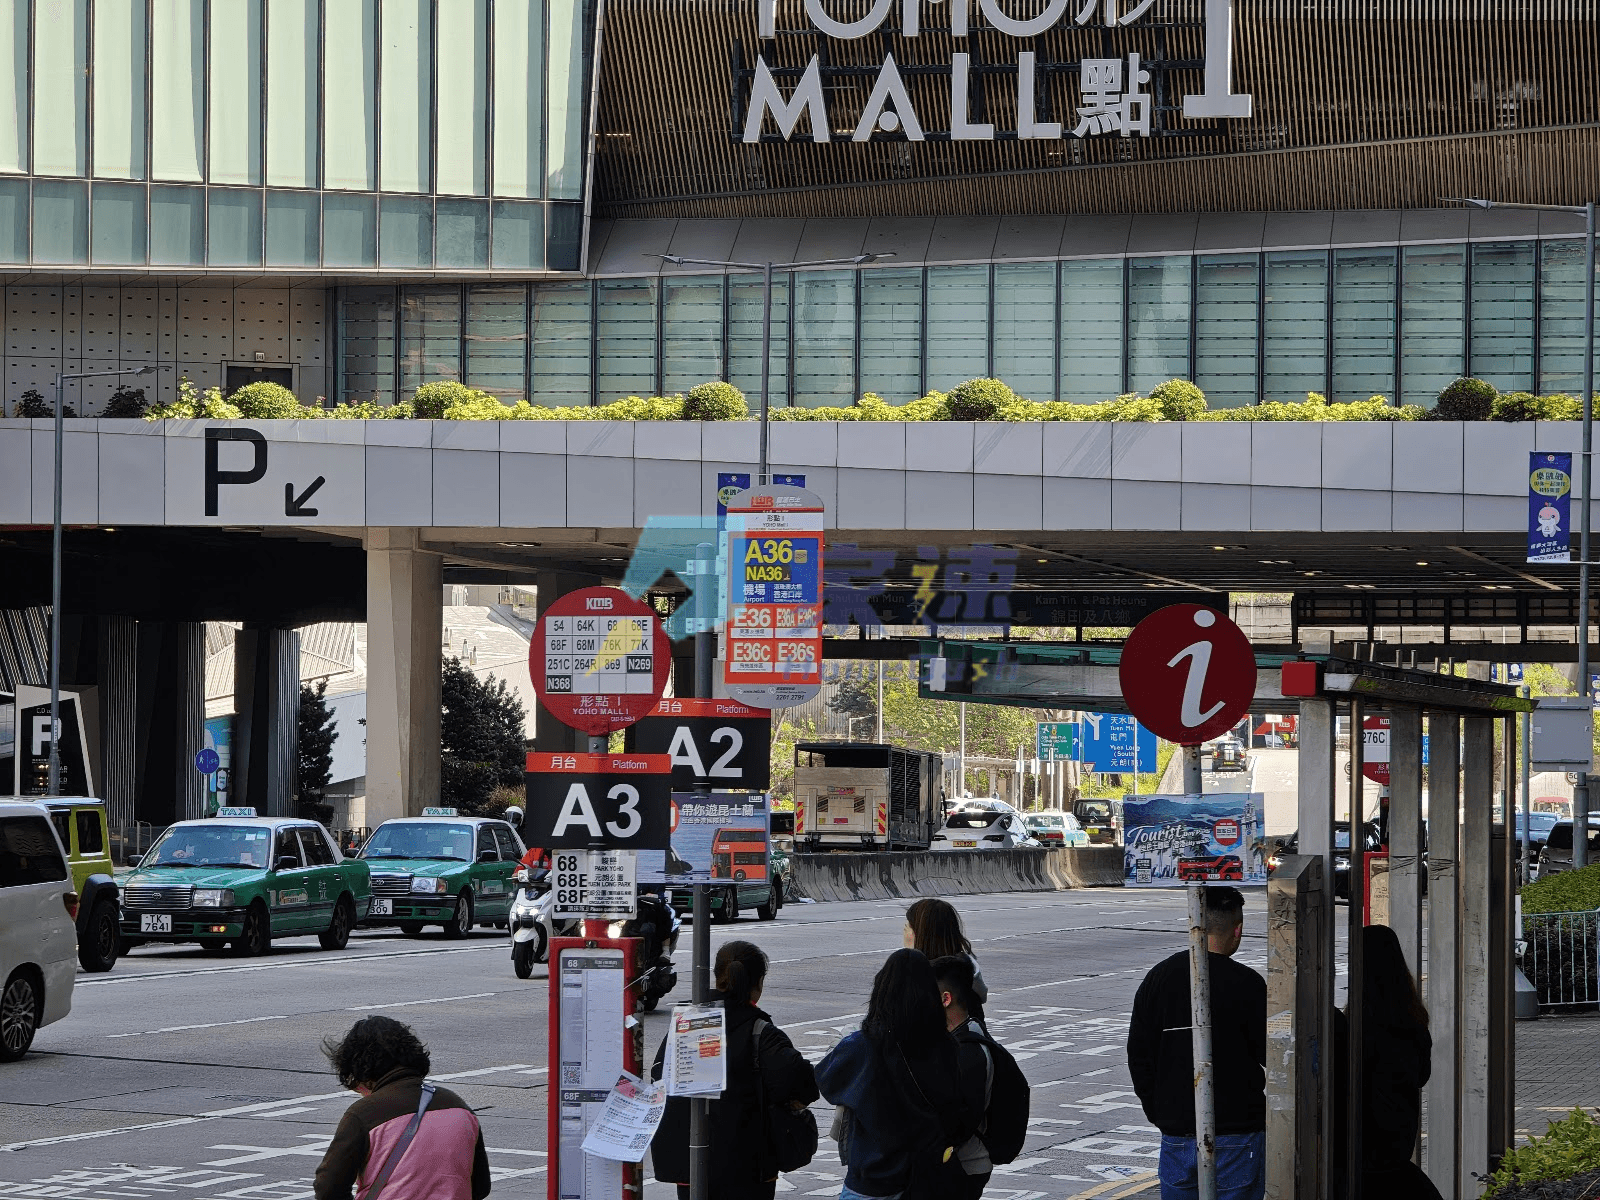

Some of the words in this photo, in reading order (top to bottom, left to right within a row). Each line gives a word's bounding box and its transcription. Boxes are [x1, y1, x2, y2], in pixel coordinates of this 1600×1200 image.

[743, 51, 1061, 143] MALL
[205, 428, 267, 516] P
[745, 540, 793, 563] A36
[746, 566, 783, 581] NA36
[743, 584, 765, 595] 機場
[586, 598, 614, 610] KMB
[882, 594, 905, 603] Mun
[1035, 596, 1058, 605] Kam
[1060, 596, 1076, 605] Tin
[1112, 596, 1147, 607] Heung
[734, 608, 771, 627] E36
[1050, 609, 1131, 624] 錦田及八鄉
[553, 620, 564, 631] 54
[577, 620, 595, 631] 64K
[607, 620, 618, 631] 68
[631, 620, 648, 631] 68E
[551, 640, 567, 651] 68F
[577, 640, 595, 651] 68M
[604, 640, 621, 651] 76K
[631, 640, 648, 651] 77K
[733, 643, 771, 661] E36C
[778, 643, 815, 661] E36S
[547, 659, 570, 670] 251C
[574, 659, 597, 670] 264R
[604, 659, 620, 670] 869
[628, 659, 651, 670] N269
[547, 678, 571, 690] N368
[580, 696, 609, 707] 形點
[657, 701, 682, 713] 月台
[716, 704, 749, 714] Platform
[1110, 733, 1127, 741] 屯門
[1363, 732, 1385, 743] 276C
[666, 726, 743, 778] A2
[551, 757, 576, 769] 月台
[612, 760, 648, 770] Platform
[221, 808, 252, 816] TAXI
[551, 783, 642, 838] A3
[682, 804, 755, 817] 帶你遊昆士蘭
[1127, 825, 1183, 849] Tourist
[557, 856, 578, 872] 68
[557, 874, 588, 888] 68E
[594, 874, 624, 882] 元朗公園
[557, 890, 588, 904] 68F
[149, 914, 163, 923] TK
[144, 922, 169, 931] 7641
[564, 959, 580, 968] 68
[564, 1092, 580, 1100] 68F
